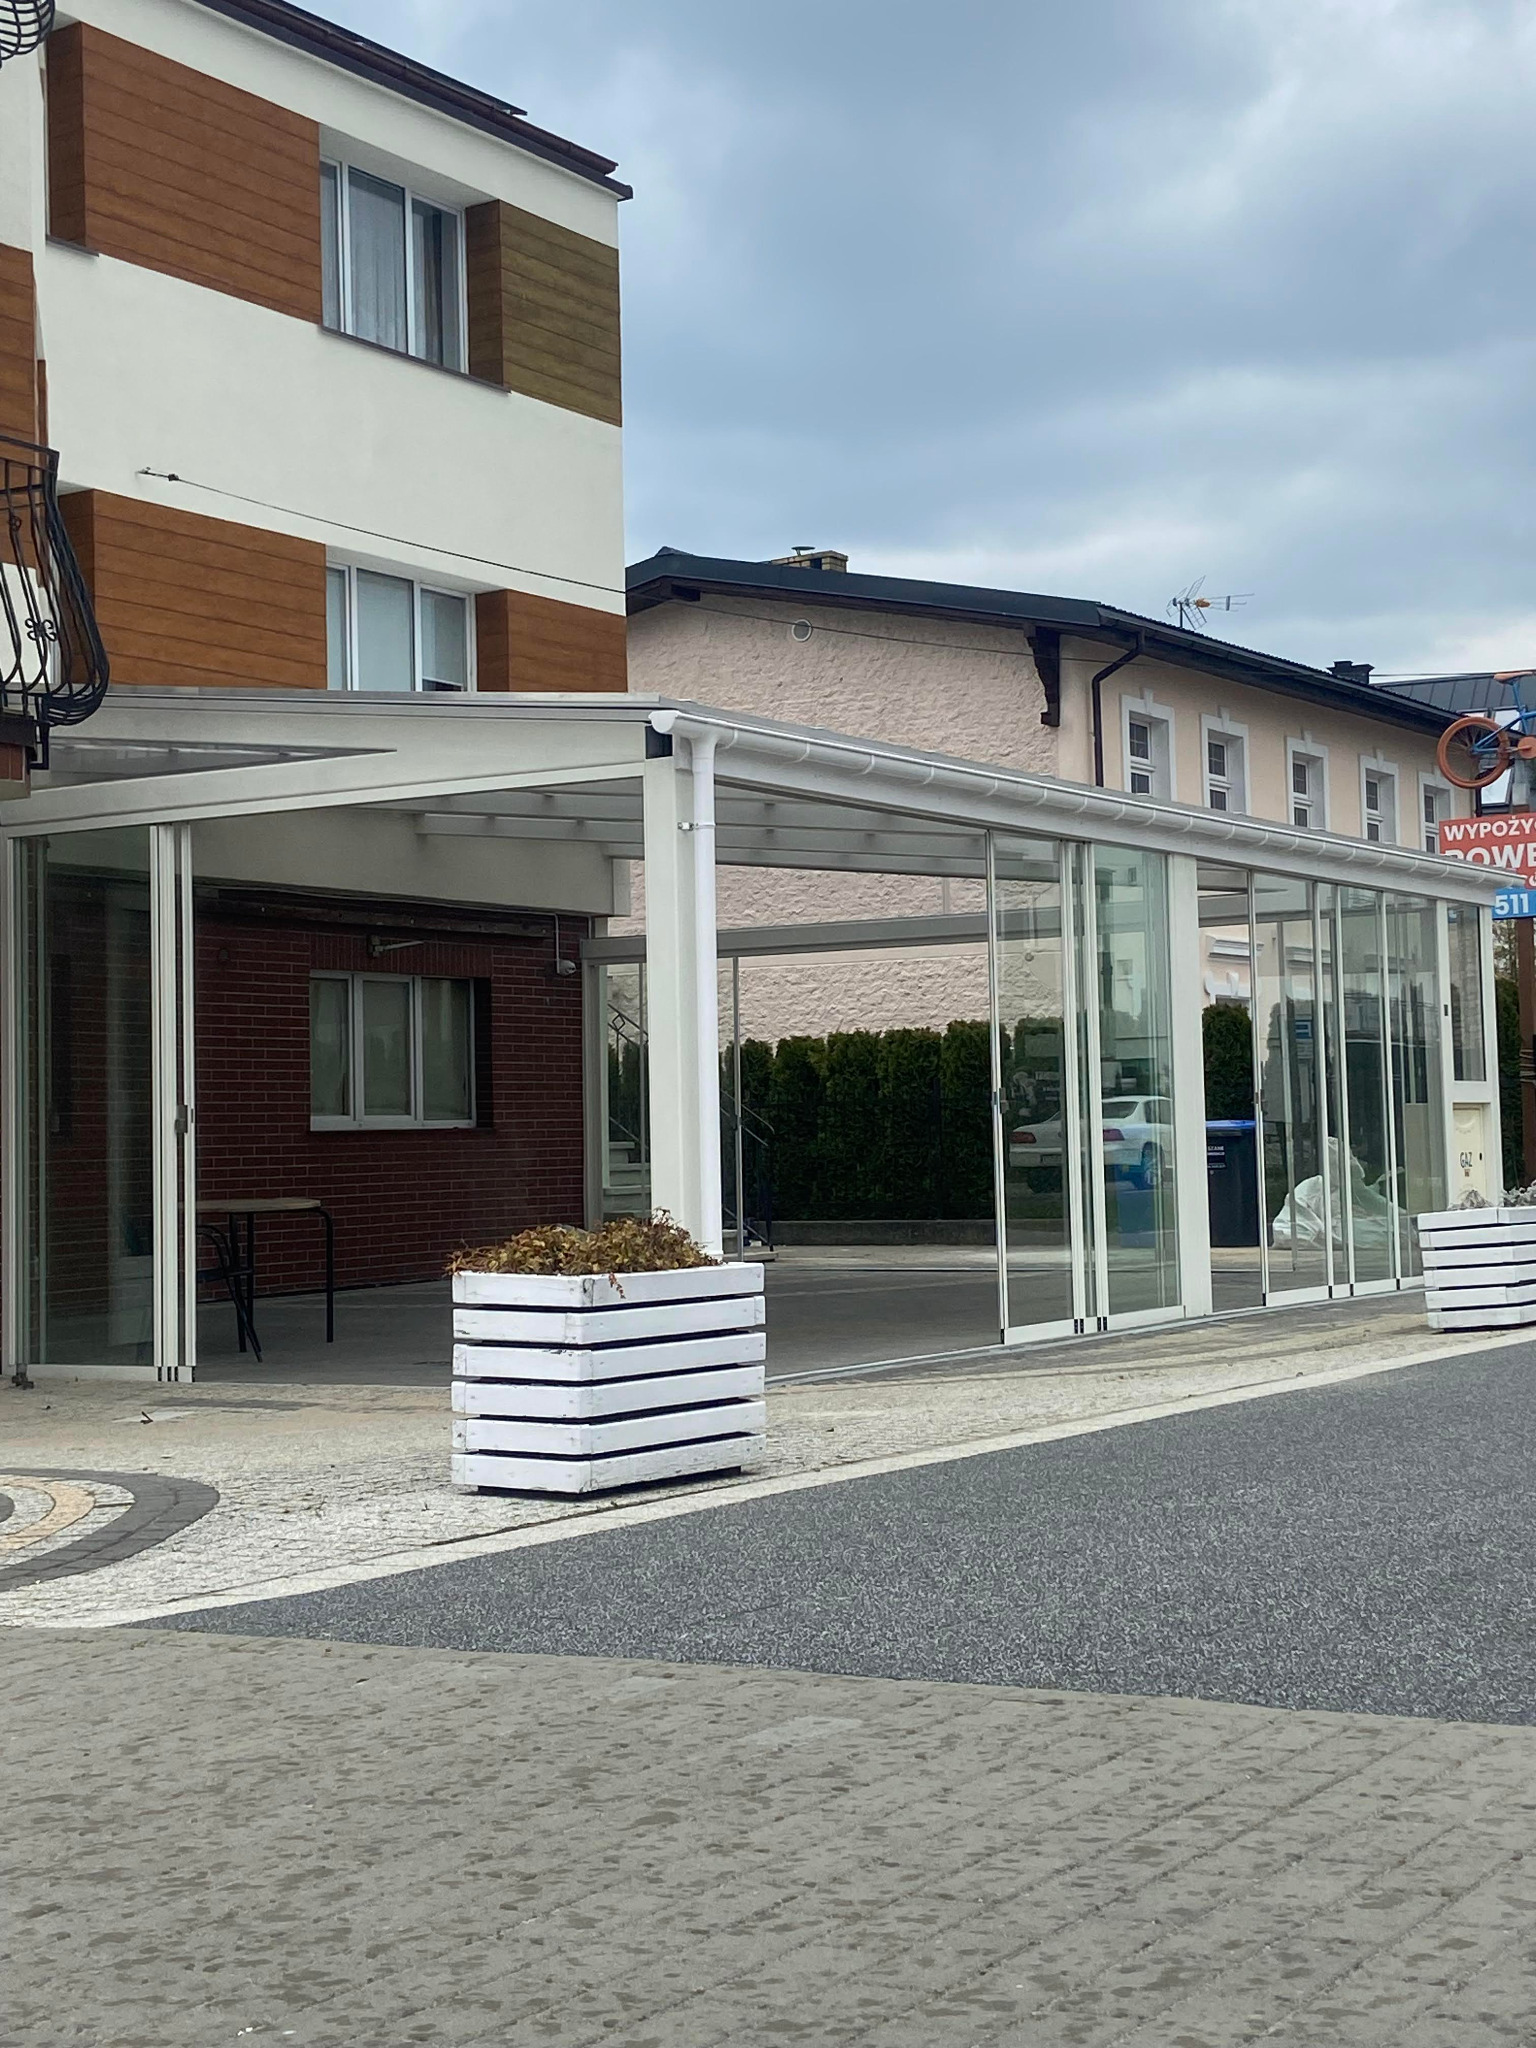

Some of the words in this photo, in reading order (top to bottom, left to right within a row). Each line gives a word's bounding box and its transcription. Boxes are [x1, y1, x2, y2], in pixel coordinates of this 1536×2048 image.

[1444, 815, 1536, 841] WYPOŻY
[1494, 893, 1529, 915] 511
[1460, 1151, 1473, 1168] GAZ
